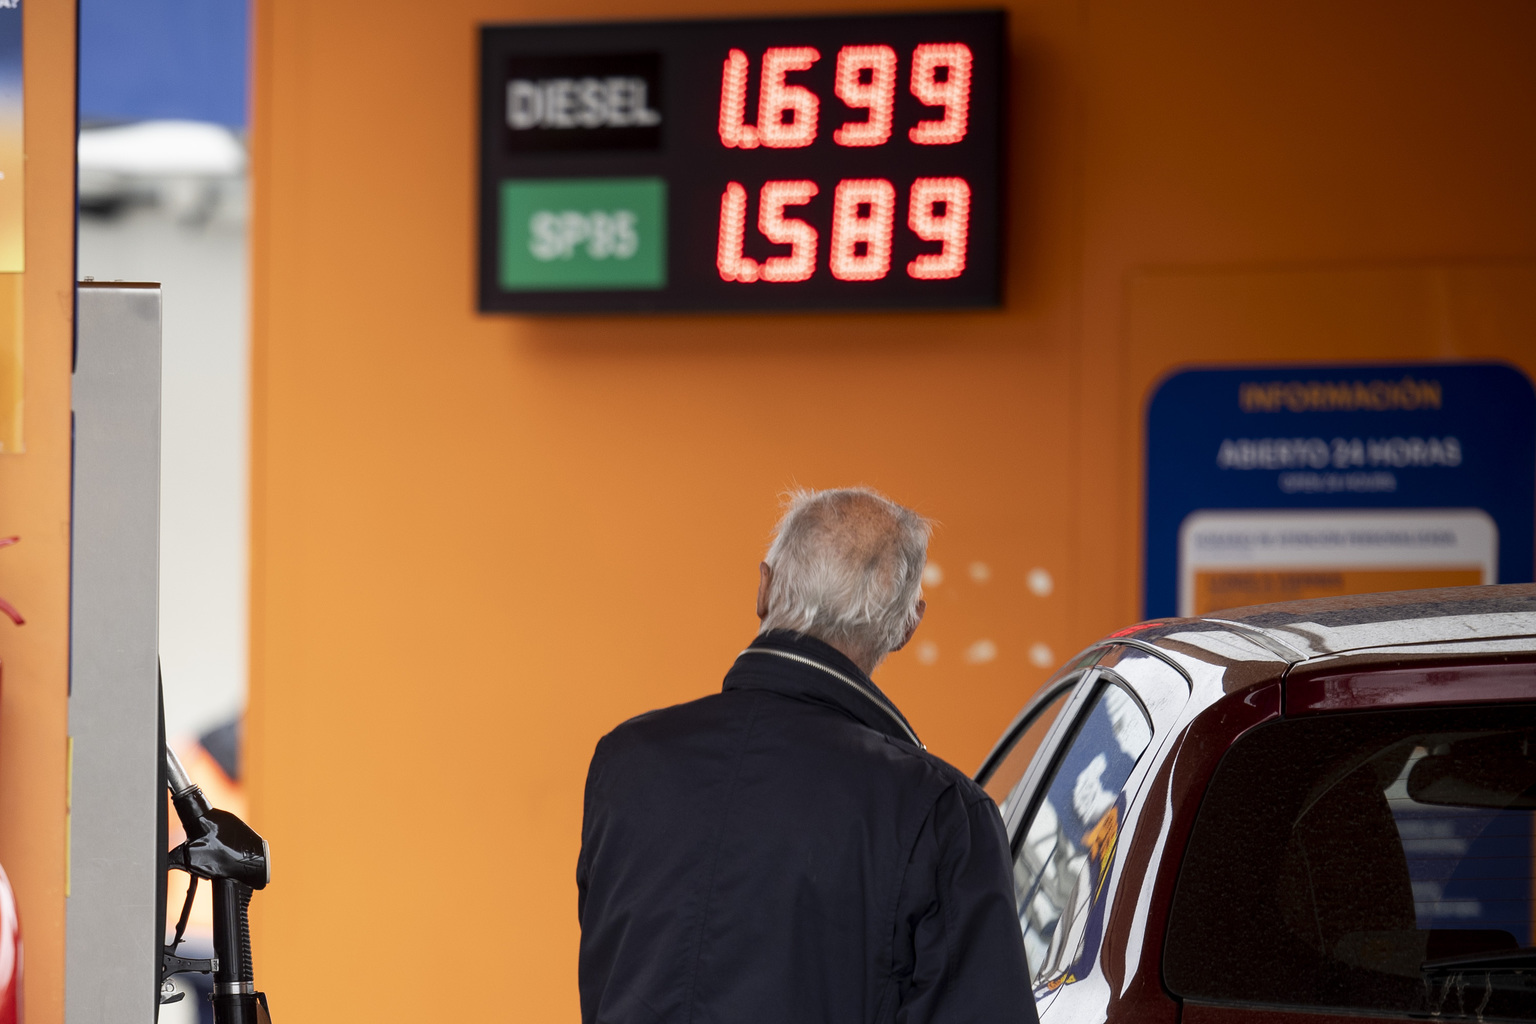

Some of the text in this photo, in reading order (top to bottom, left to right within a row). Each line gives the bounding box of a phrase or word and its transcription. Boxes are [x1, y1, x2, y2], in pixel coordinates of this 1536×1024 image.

[506, 77, 660, 130] DIESEL
[718, 43, 973, 149] 1.699
[717, 177, 971, 283] 1.589
[1219, 437, 1461, 468] ABIERTO 24 HORAS
